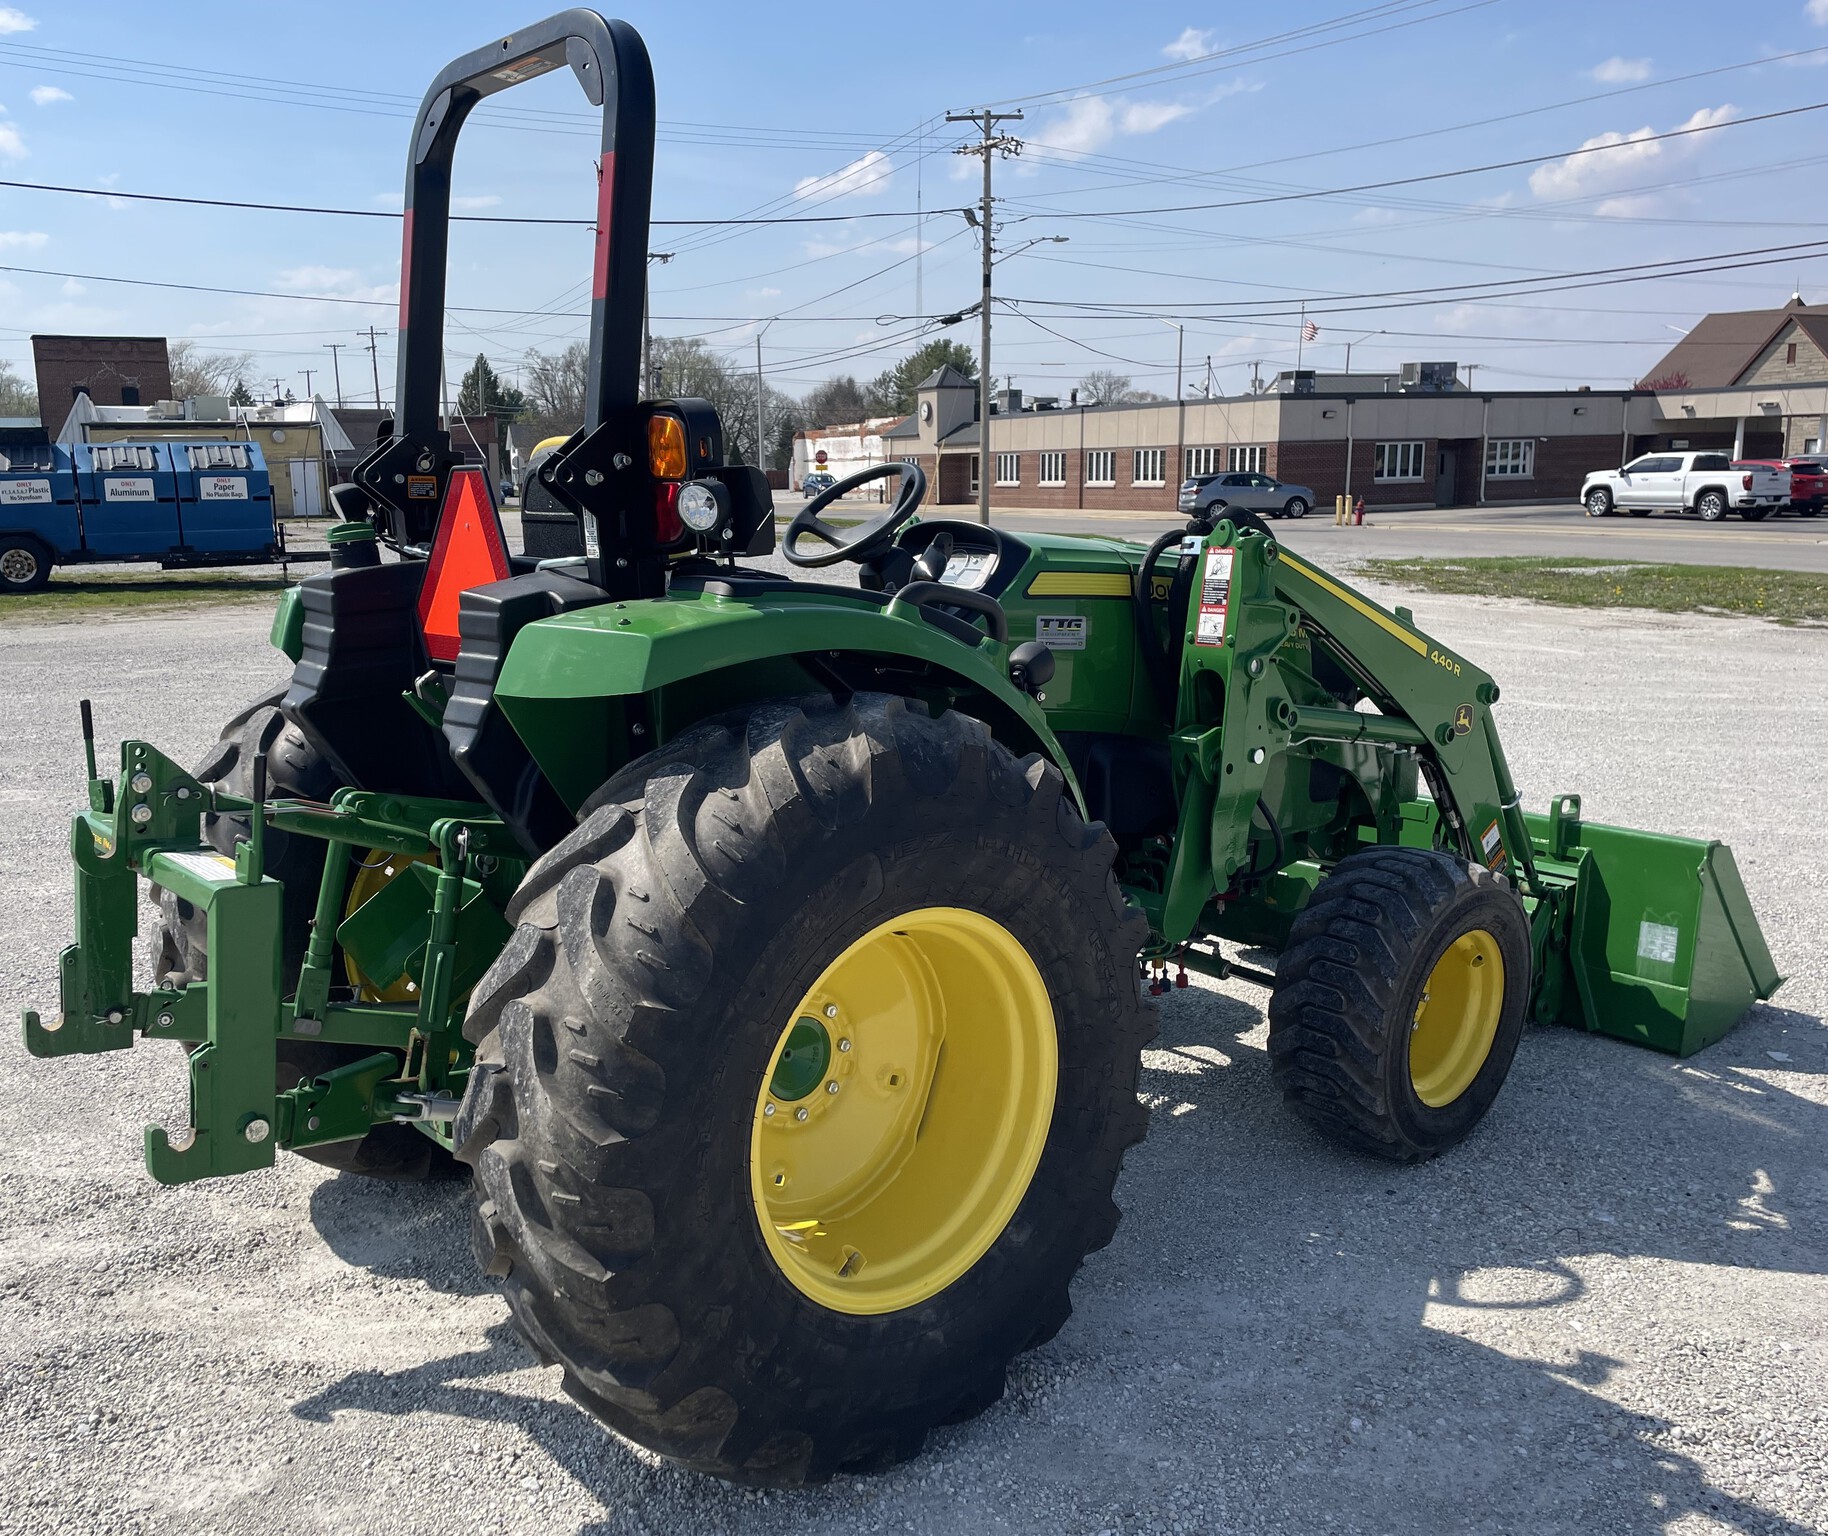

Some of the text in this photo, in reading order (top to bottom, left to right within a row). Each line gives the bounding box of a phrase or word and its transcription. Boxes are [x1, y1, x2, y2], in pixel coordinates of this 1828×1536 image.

[213, 483, 235, 492] Paper
[110, 488, 150, 496] Aluminum
[1040, 618, 1083, 631] TTG
[1295, 642, 1308, 650] DUTY
